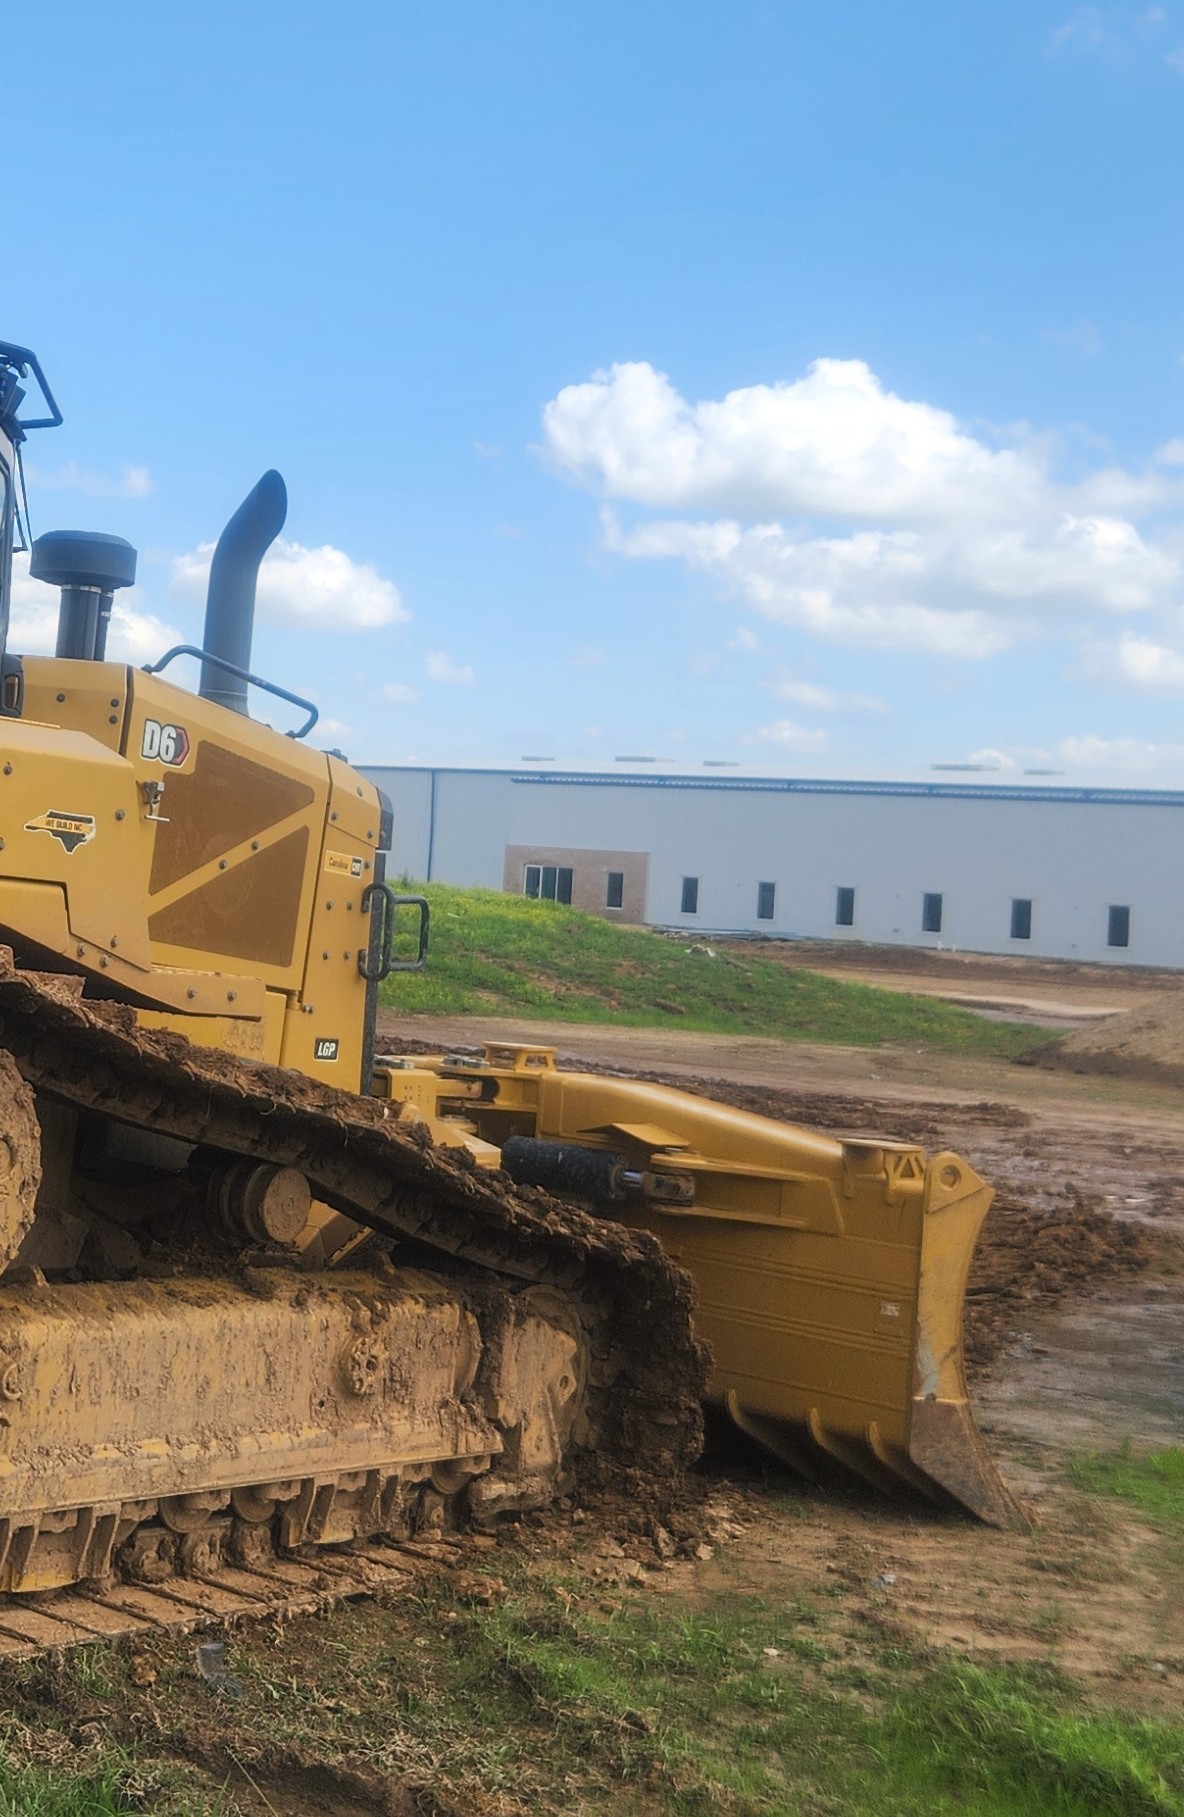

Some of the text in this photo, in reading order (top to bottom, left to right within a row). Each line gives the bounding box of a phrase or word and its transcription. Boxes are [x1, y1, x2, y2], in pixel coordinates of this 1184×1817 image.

[142, 720, 177, 762] D6
[45, 819, 55, 828] WE
[56, 820, 73, 830] BUILD
[318, 1041, 336, 1056] LGP
